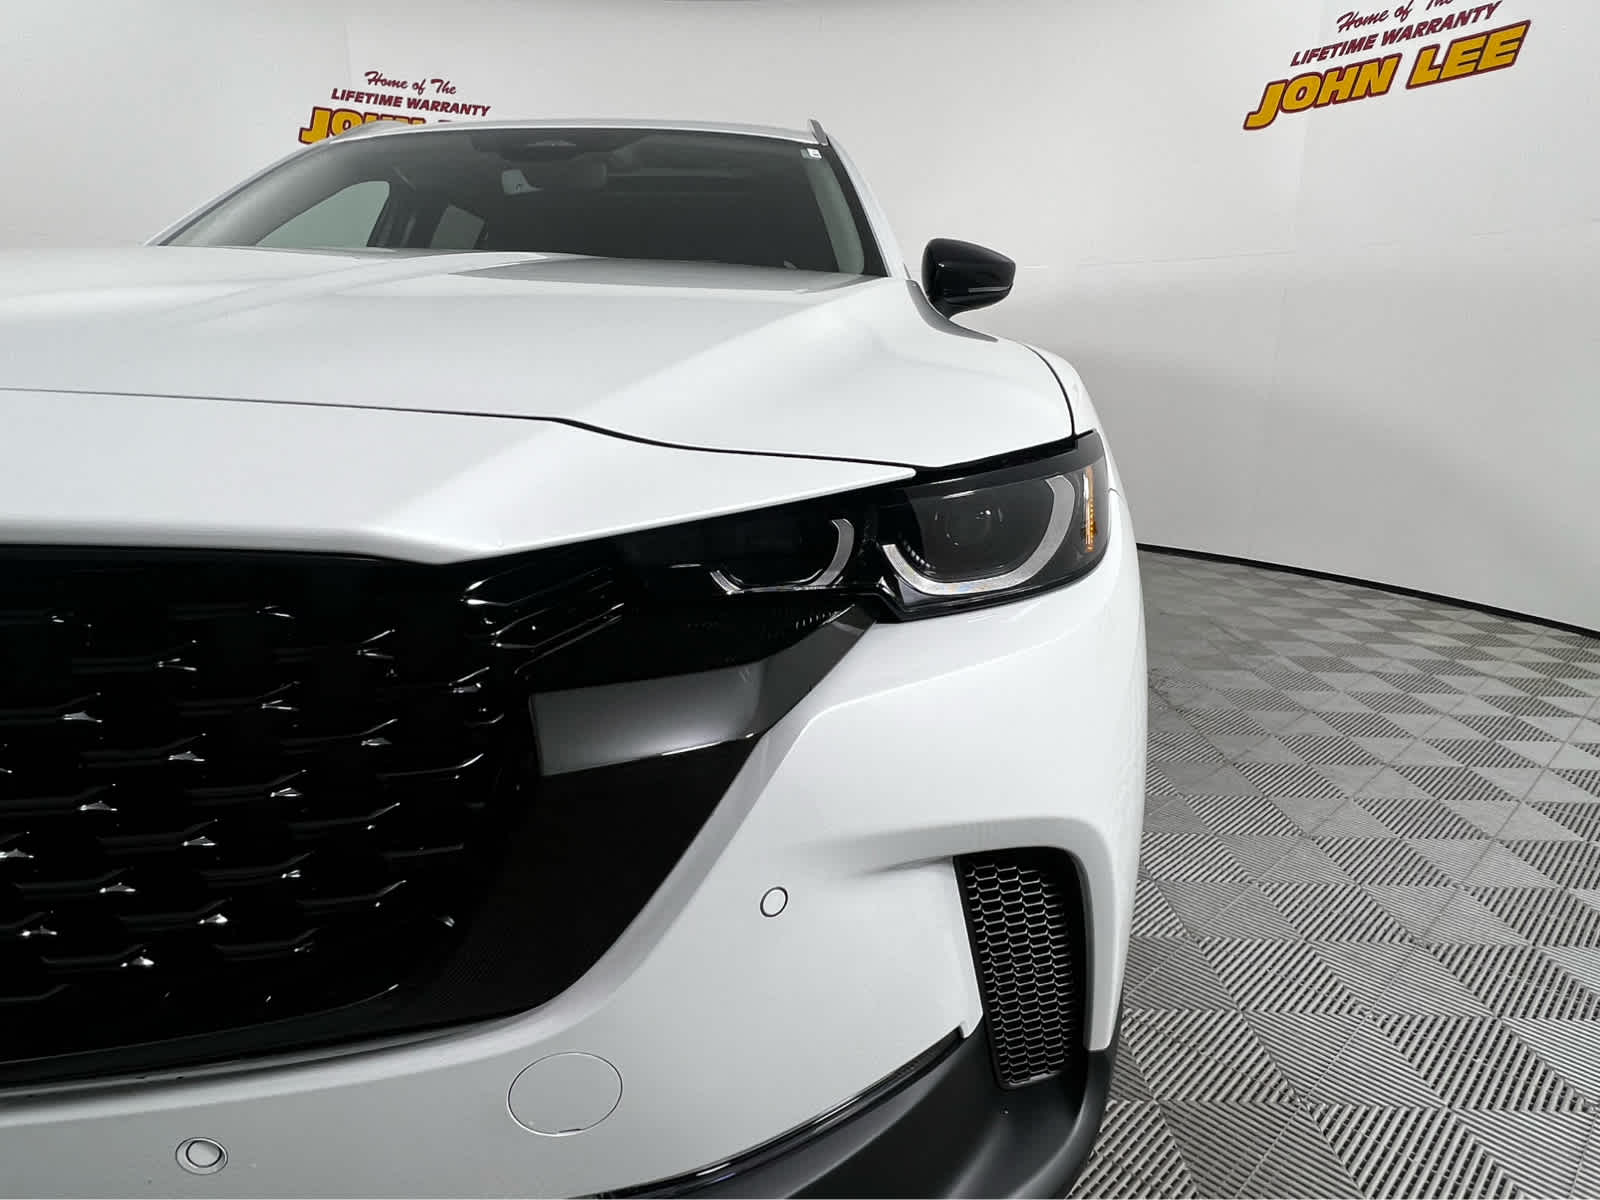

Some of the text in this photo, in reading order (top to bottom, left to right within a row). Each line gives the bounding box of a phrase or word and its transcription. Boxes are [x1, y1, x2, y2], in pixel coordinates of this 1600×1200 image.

[1336, 11, 1389, 33] Home
[1394, 0, 1413, 23] of
[1290, 1, 1502, 67] LIFETIME WARRANTY
[364, 71, 457, 95] Home of The
[1243, 19, 1531, 130] JOHN LEE
[331, 88, 492, 117] LIFETIME WARRANTY
